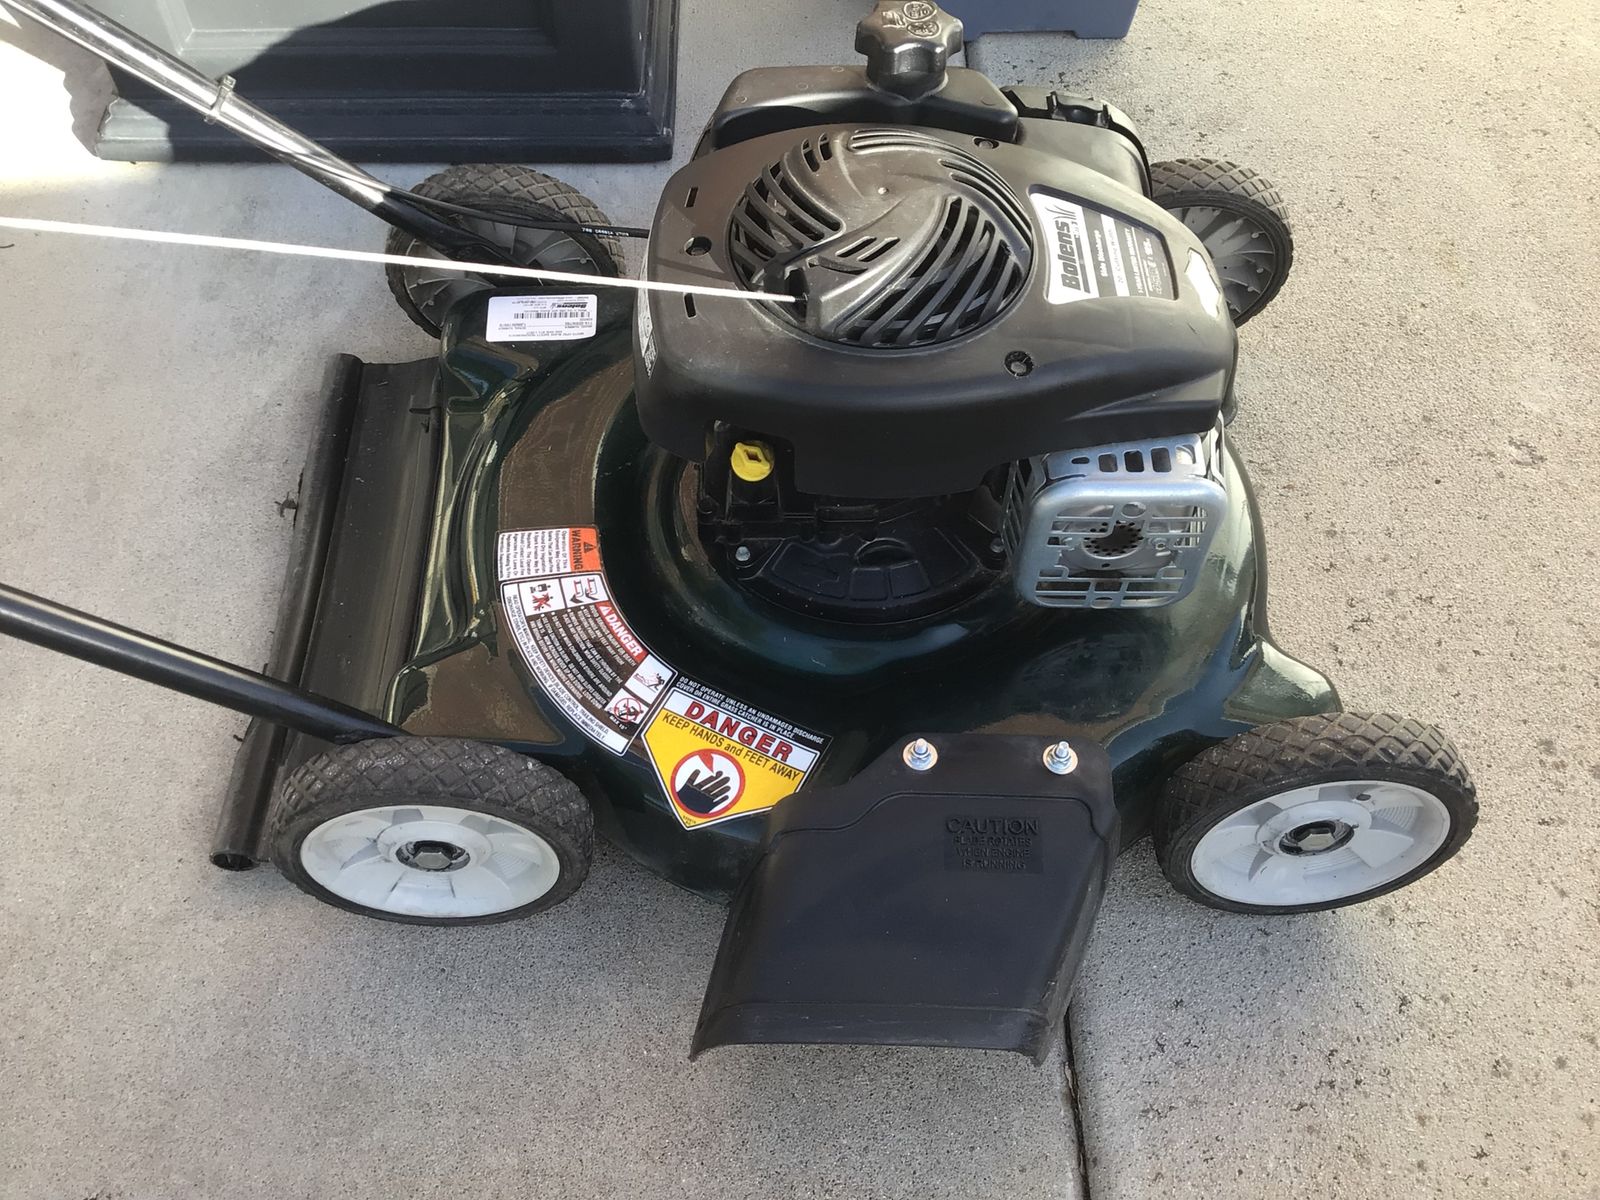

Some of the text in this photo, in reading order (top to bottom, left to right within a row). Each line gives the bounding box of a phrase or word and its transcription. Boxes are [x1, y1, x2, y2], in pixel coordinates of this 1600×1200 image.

[1055, 219, 1081, 293] Bolens
[1093, 229, 1108, 277] Side Discharge
[572, 530, 583, 570] WARNING
[605, 612, 644, 657] DANGER
[676, 681, 694, 694] COVER
[693, 690, 702, 698] OR
[702, 693, 721, 706] ENTIRE
[720, 702, 738, 714] GRASS
[737, 709, 763, 725] CATCHER
[769, 723, 777, 731] IN
[776, 726, 796, 739] PLACE.
[680, 676, 824, 745] DO NOT OPERATE UNLESS AN UNDAMAGED DISCHARGE
[684, 700, 795, 763] DANGER
[662, 712, 801, 783] KEEP HANDS and FEET AWAY
[945, 818, 1039, 836] CAUTION
